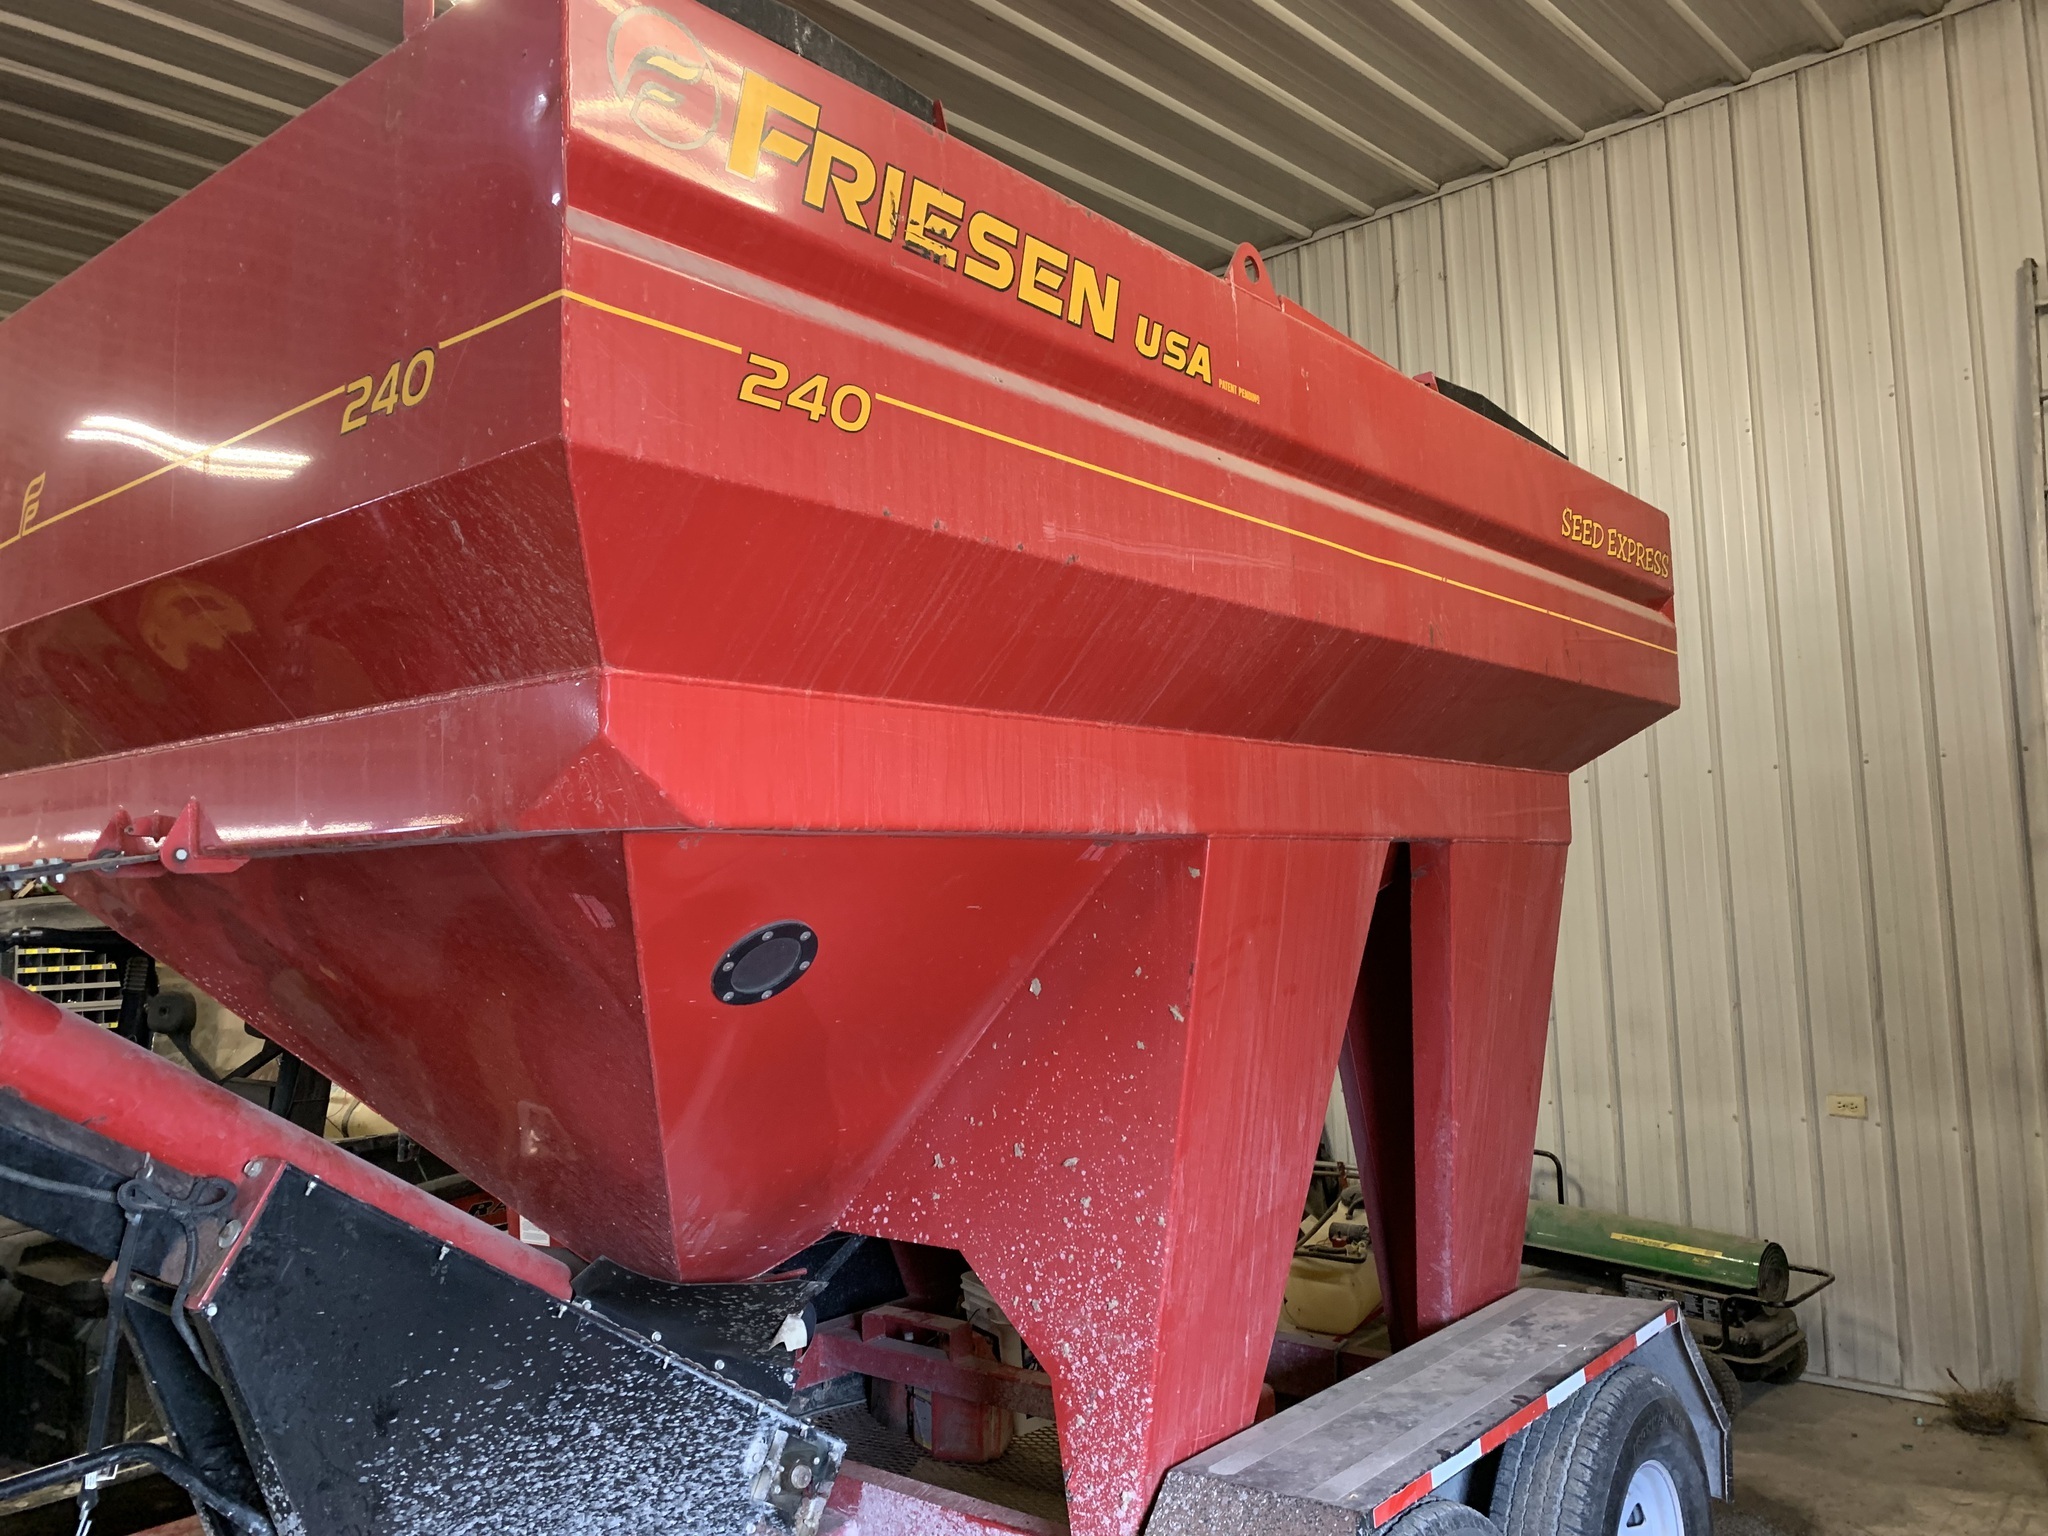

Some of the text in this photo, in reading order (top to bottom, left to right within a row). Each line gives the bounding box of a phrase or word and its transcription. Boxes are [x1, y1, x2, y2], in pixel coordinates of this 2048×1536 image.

[726, 68, 1213, 385] FRIESEN USA
[339, 348, 436, 435] 240
[738, 352, 873, 433] 240
[1561, 507, 1669, 579] SEED EXPRESS
